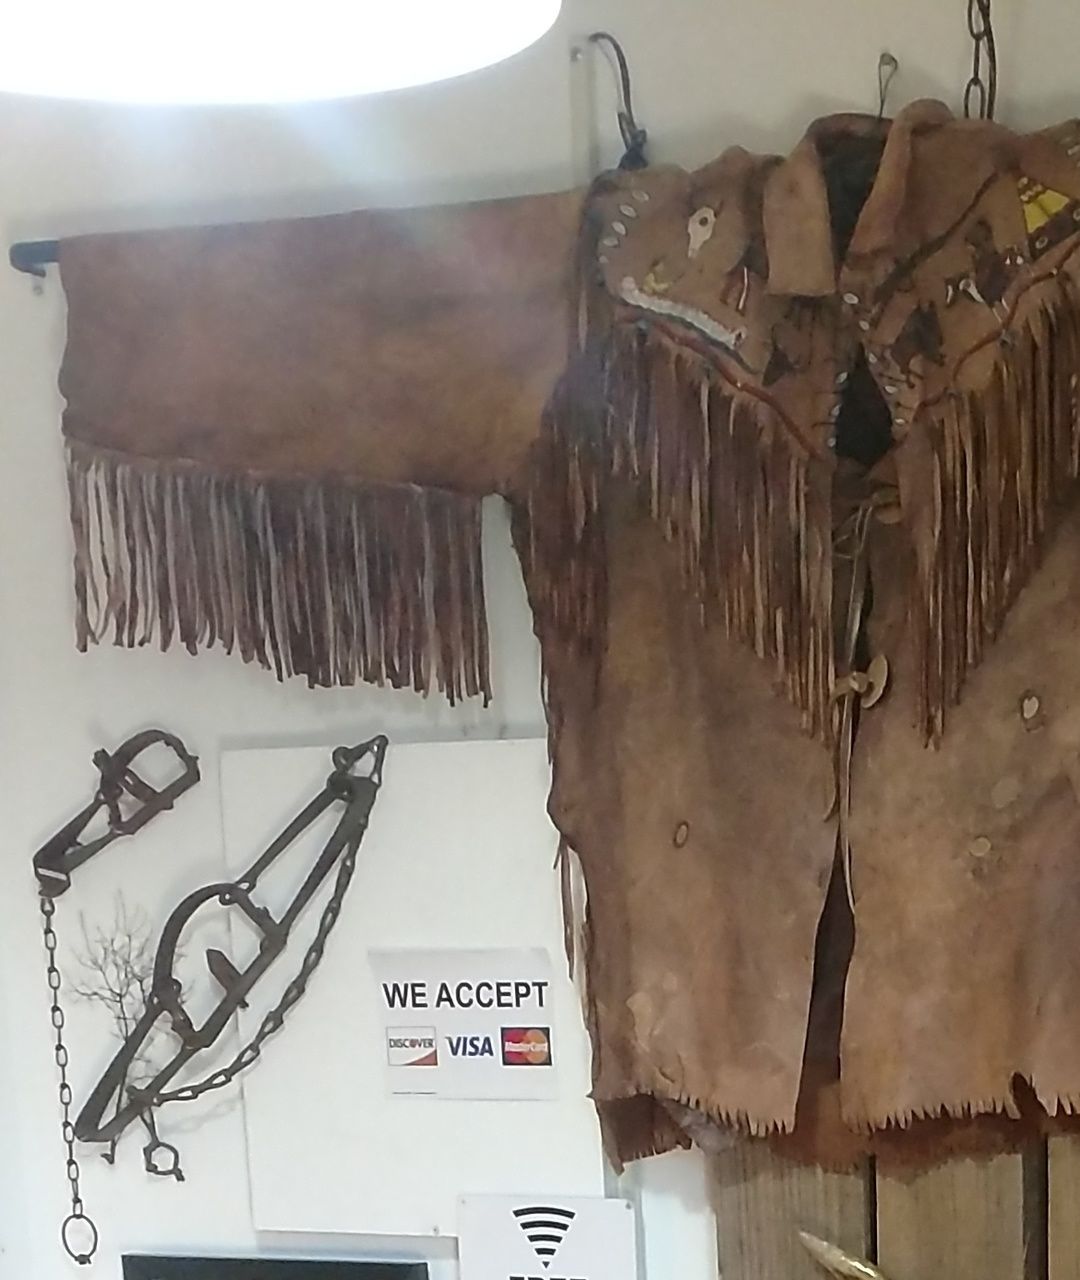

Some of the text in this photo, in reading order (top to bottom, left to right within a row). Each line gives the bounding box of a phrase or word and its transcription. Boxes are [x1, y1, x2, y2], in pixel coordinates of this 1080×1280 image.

[382, 981, 549, 1009] WE ACCEPT
[388, 1038, 435, 1049] DISCOVER
[445, 1036, 494, 1057] VISA
